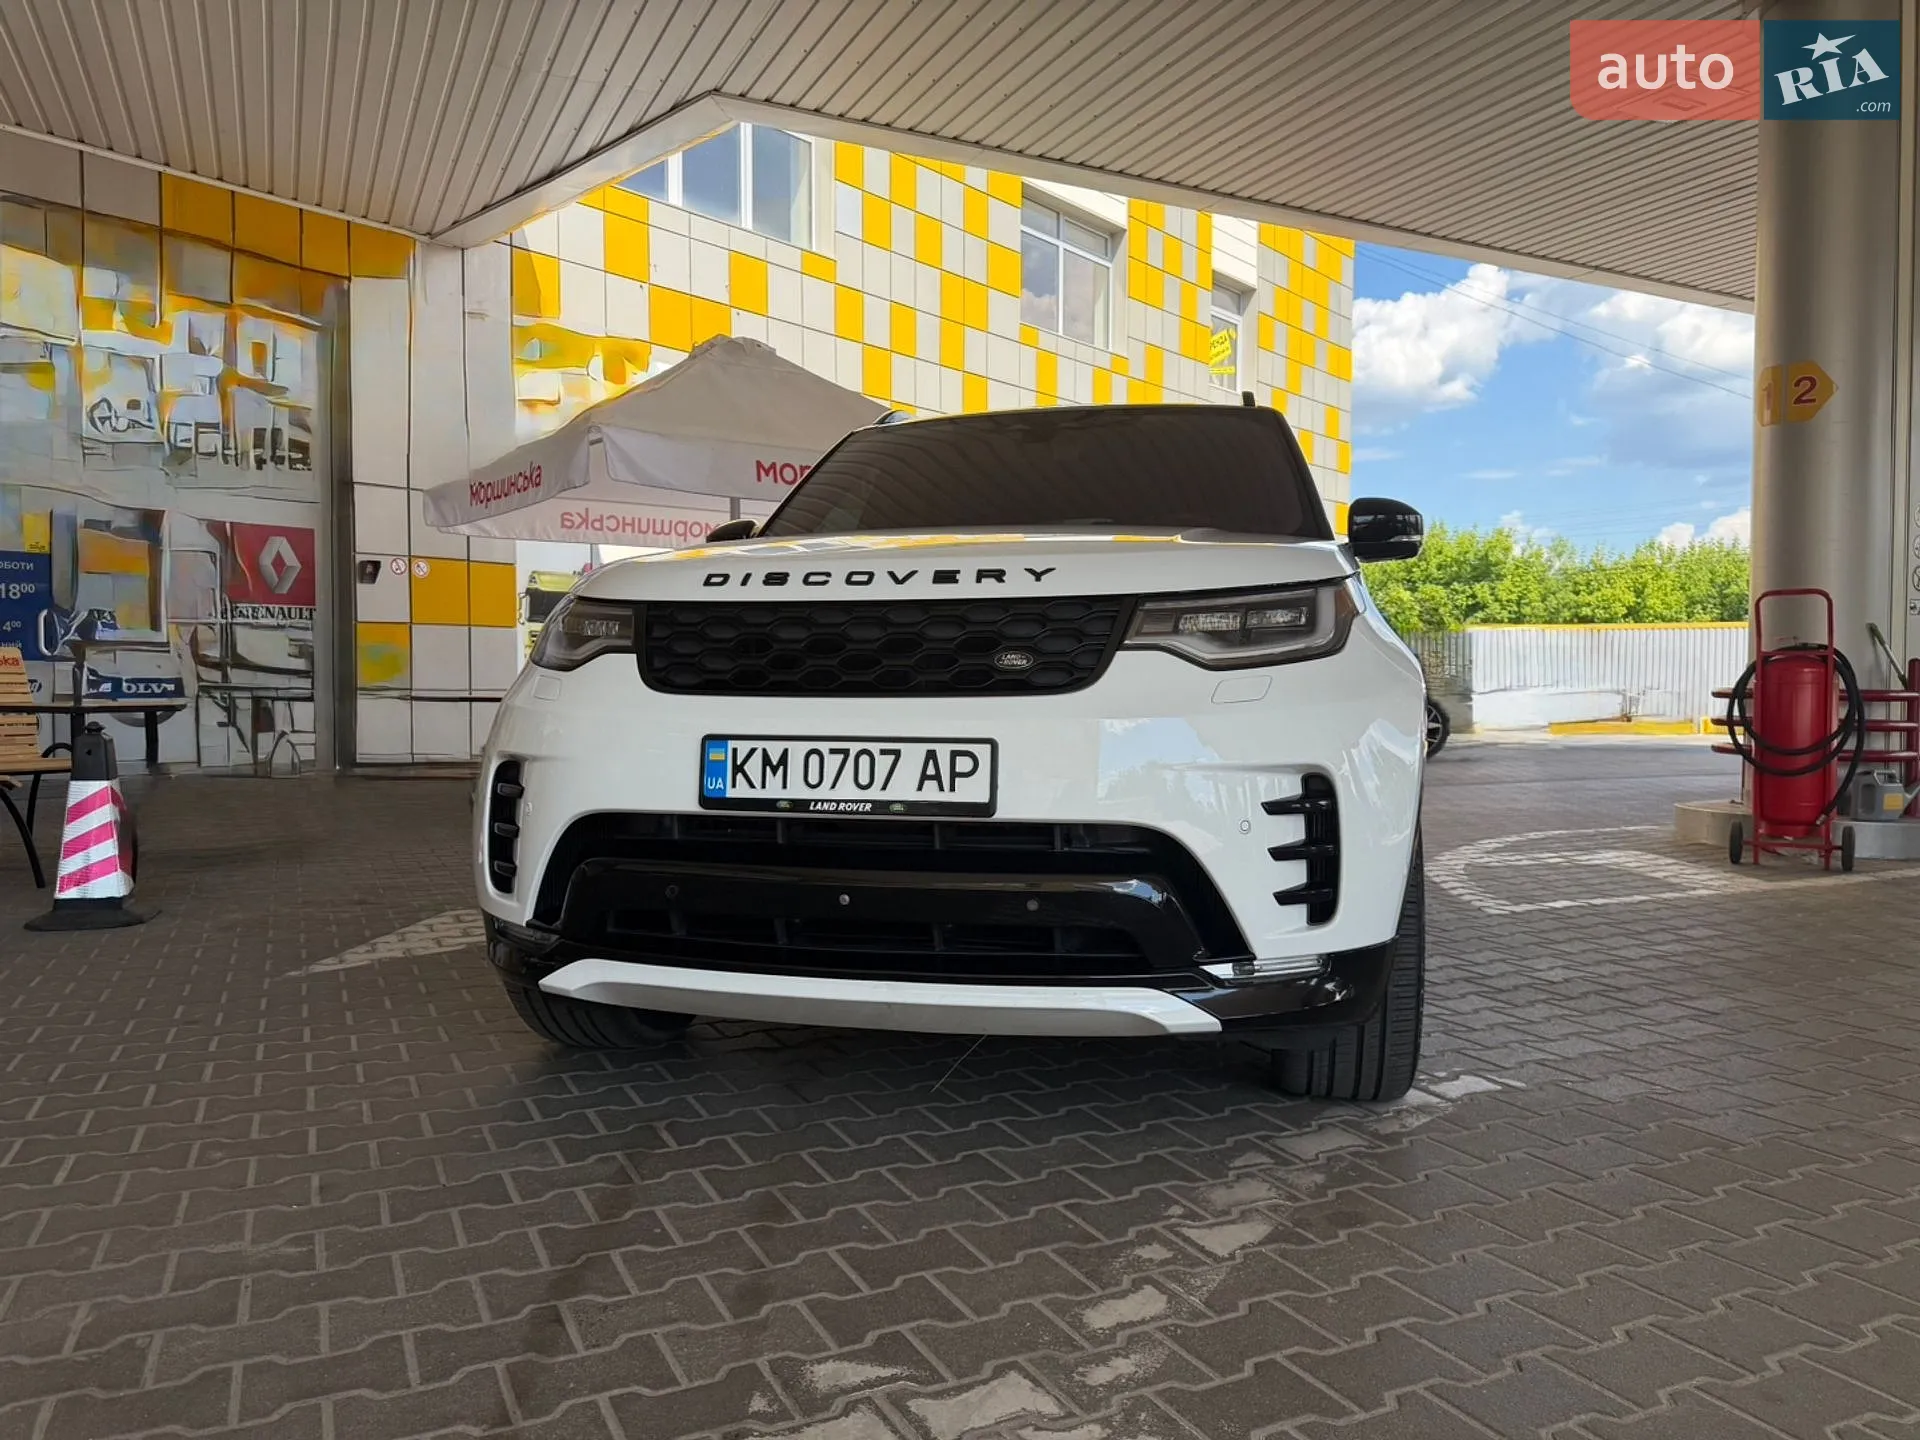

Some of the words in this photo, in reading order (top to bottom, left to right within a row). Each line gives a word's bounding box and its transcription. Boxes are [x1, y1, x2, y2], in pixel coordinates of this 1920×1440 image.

[1793, 375, 1817, 405] 2
[702, 567, 1056, 587] DISCOVERY
[731, 747, 789, 790] KM
[803, 748, 901, 792] 0707
[916, 749, 980, 793] AP
[707, 776, 724, 790] UA
[809, 801, 837, 811] LAND
[838, 802, 872, 812] ROVER
